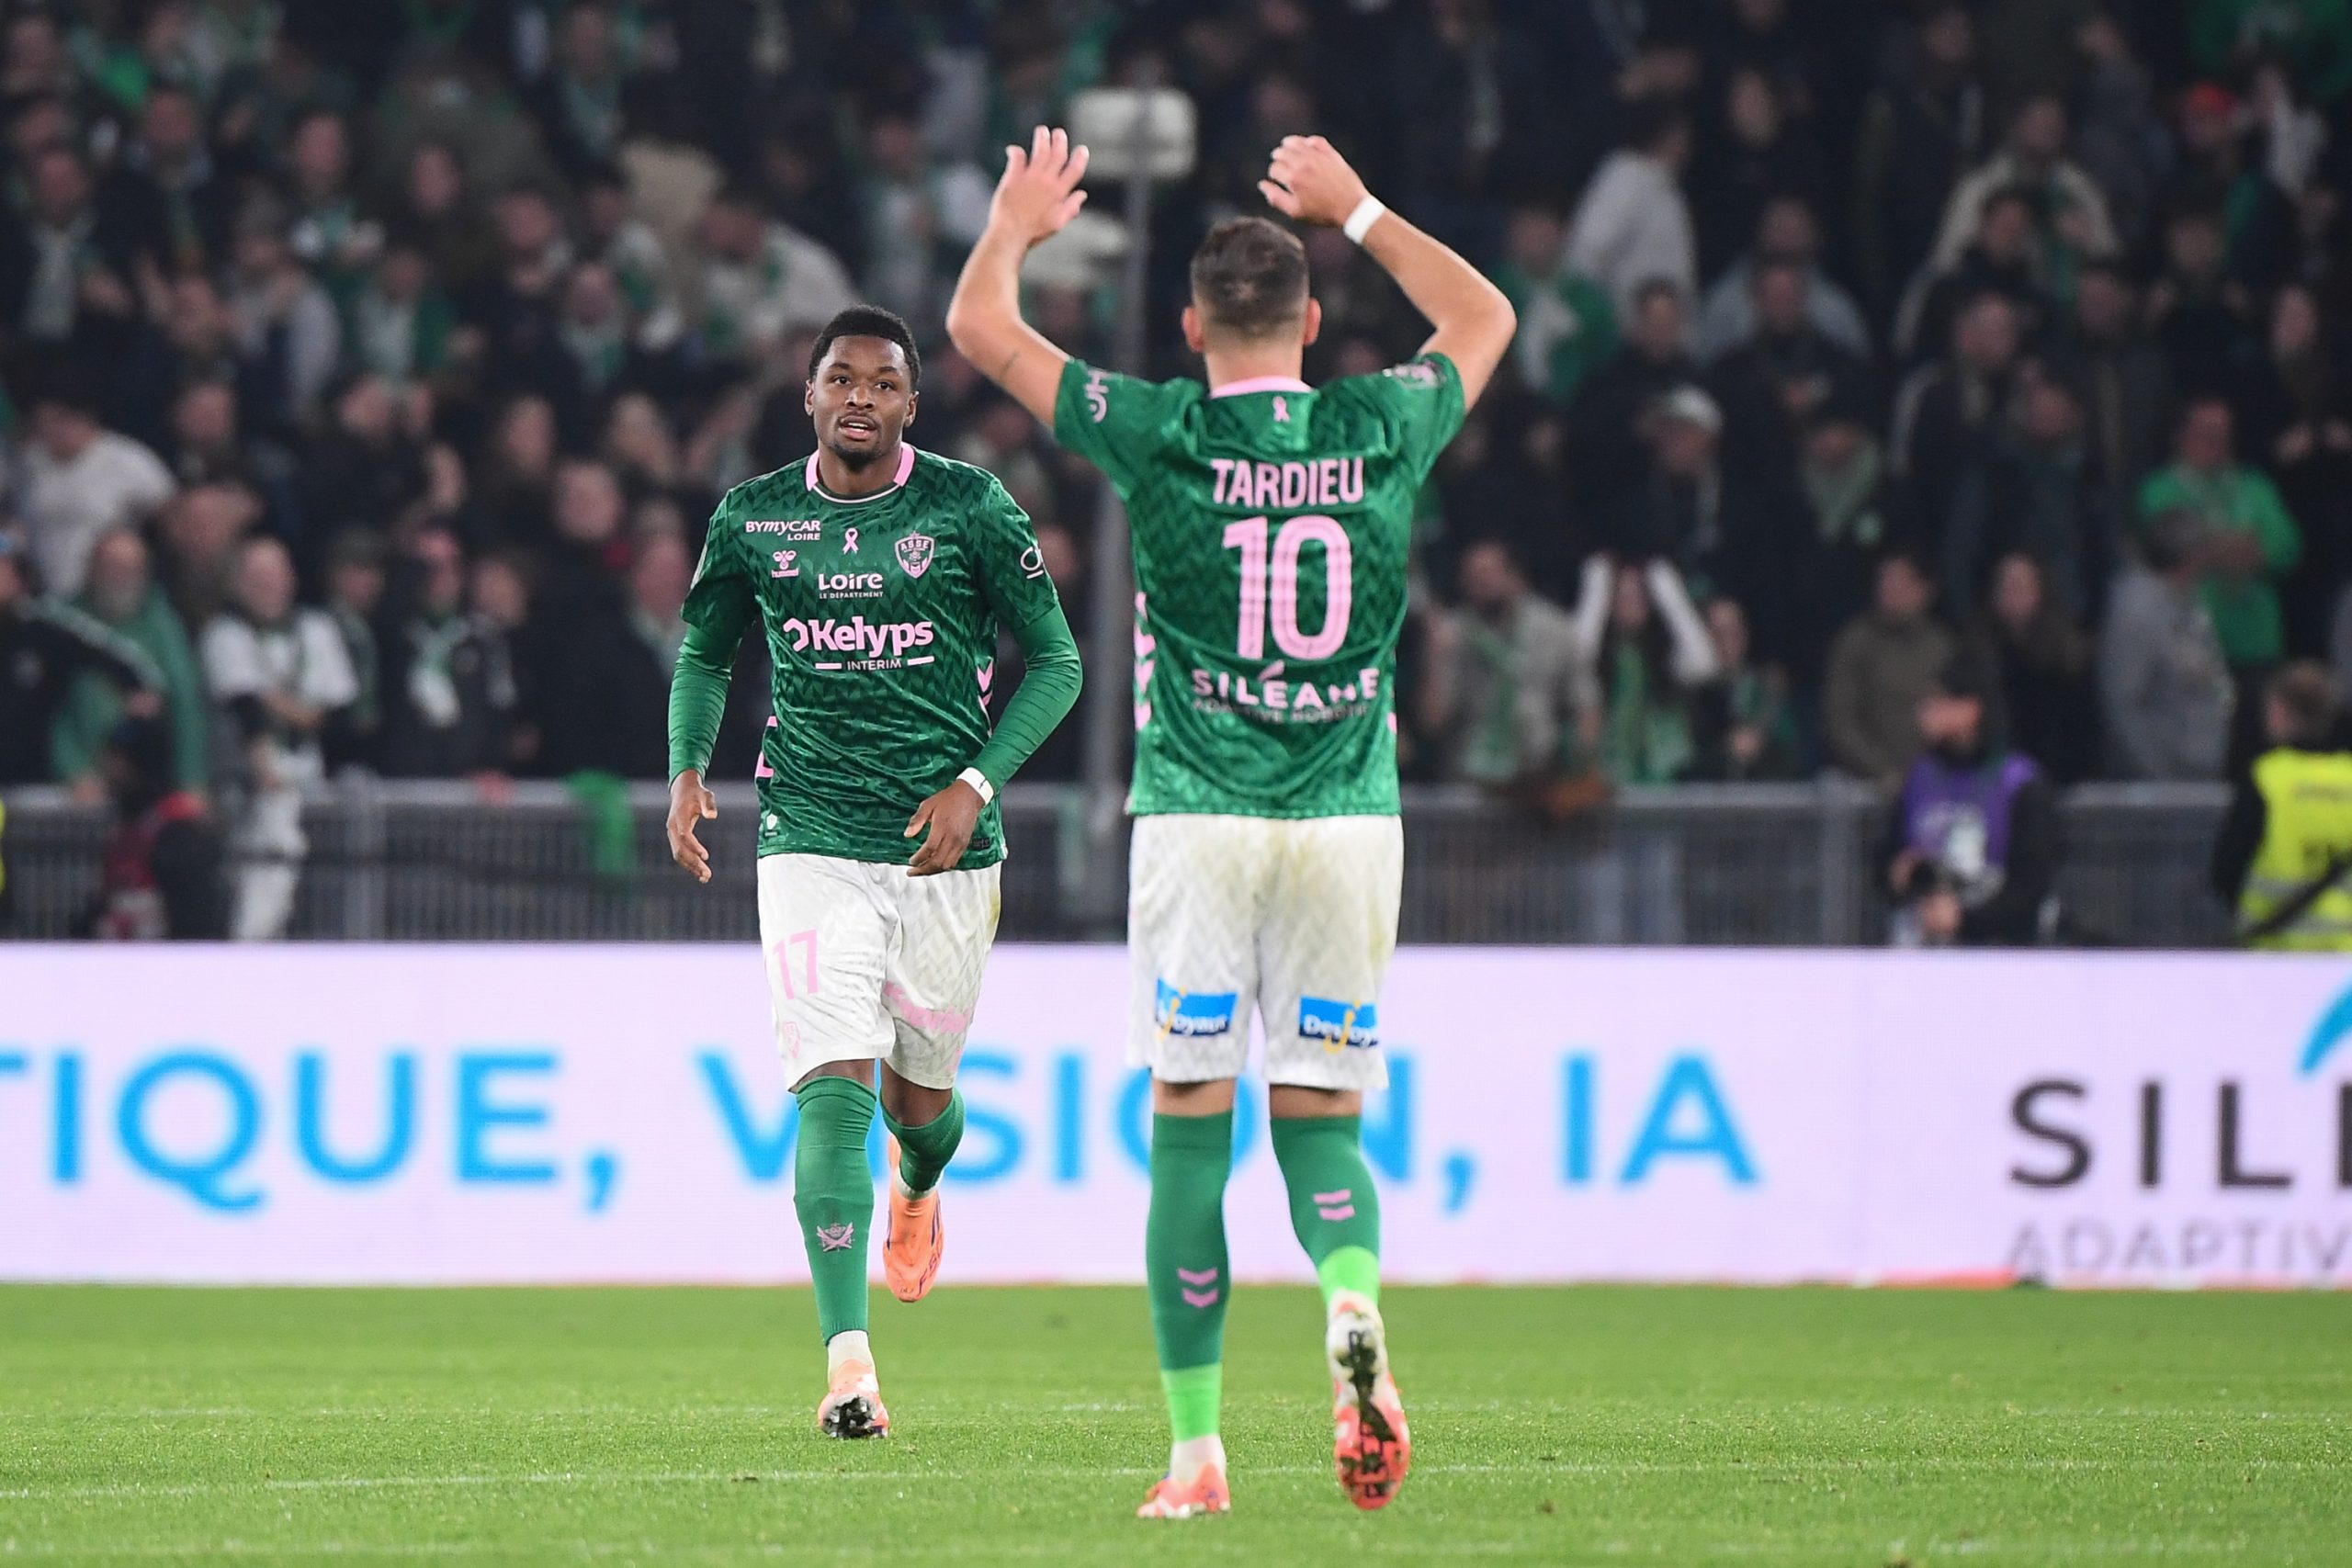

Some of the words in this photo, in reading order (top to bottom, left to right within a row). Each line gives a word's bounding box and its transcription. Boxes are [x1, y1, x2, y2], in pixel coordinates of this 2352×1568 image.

[1209, 457, 1364, 508] TARDIEU
[786, 533, 820, 541] LOIRE
[818, 572, 884, 591] Loire
[1222, 513, 1352, 661] 10
[808, 615, 934, 658] Kelyps
[847, 659, 902, 671] INTERIM
[773, 929, 820, 1000] 17
[1563, 1051, 1761, 1185] IA
[2010, 1079, 2352, 1188] SIL
